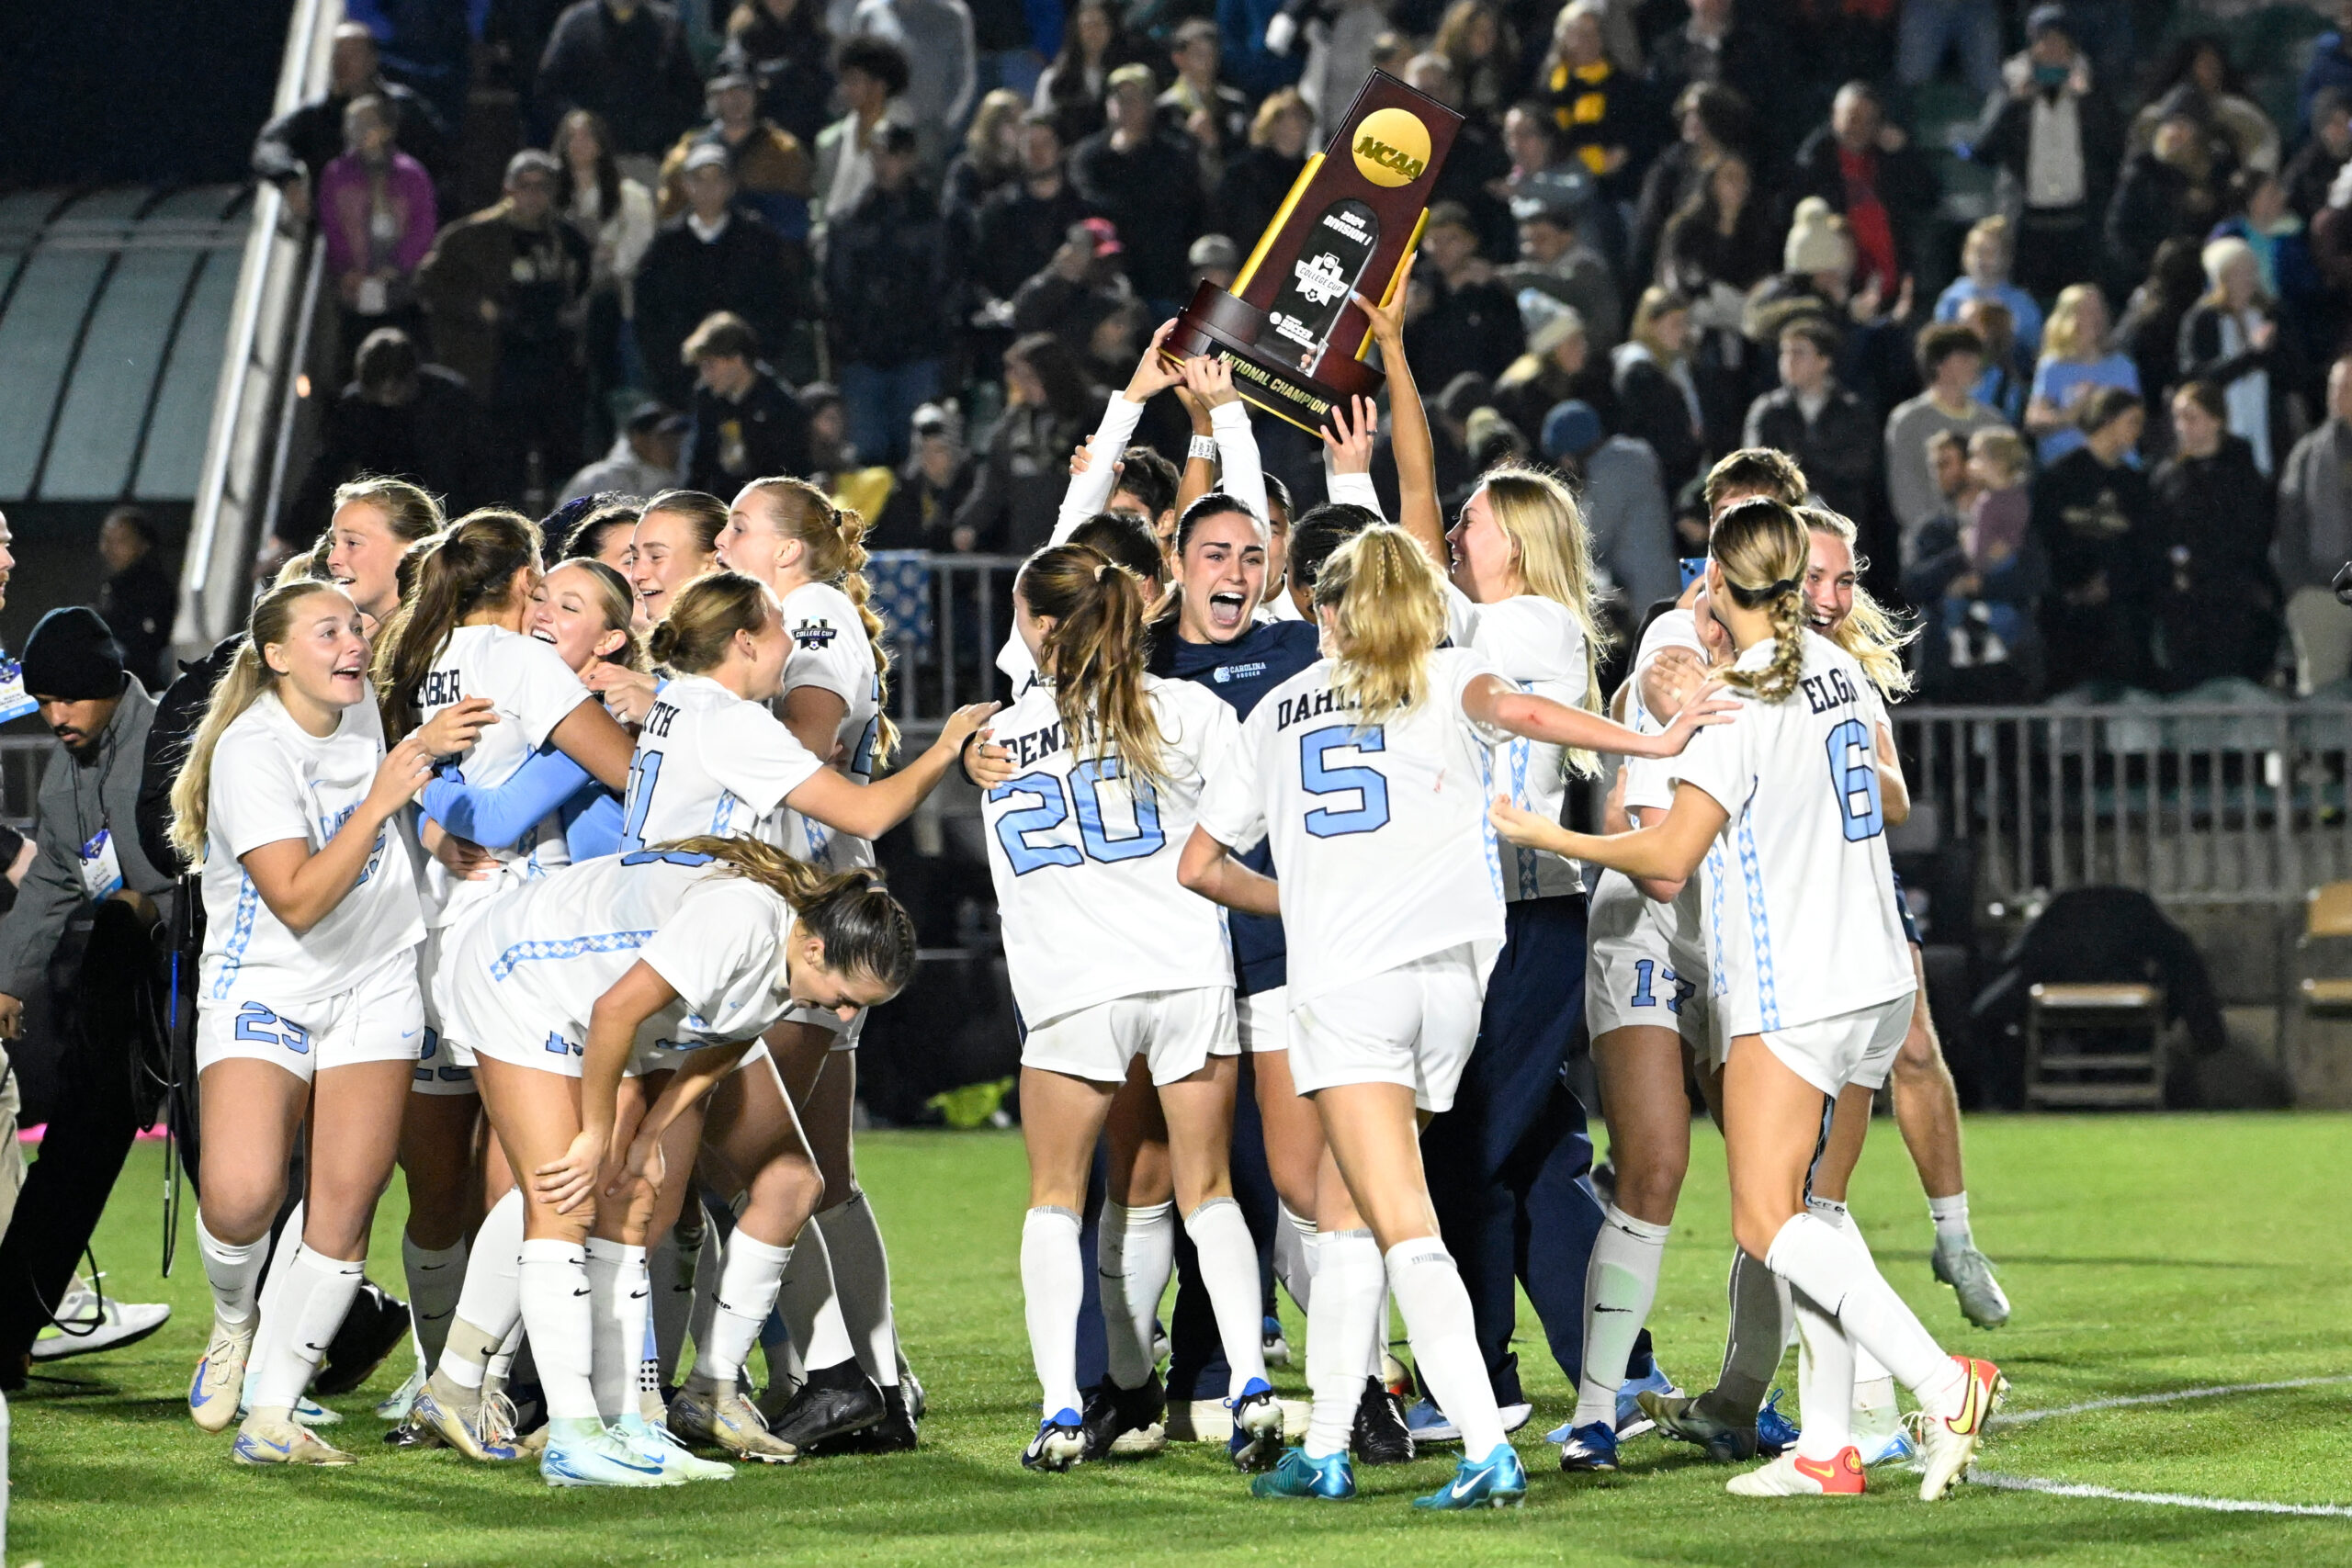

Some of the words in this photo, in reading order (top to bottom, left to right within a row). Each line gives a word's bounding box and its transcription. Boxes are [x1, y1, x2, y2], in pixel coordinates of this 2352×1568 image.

[1353, 134, 1424, 181] NCAA
[1322, 214, 1368, 243] DIVISION
[1340, 210, 1367, 230] 2024
[1299, 266, 1329, 286] COLLEGE
[1327, 281, 1343, 293] CUP
[1217, 350, 1272, 387] NATIONAL
[1269, 378, 1330, 415] CHAMPION
[1230, 661, 1267, 673] CAROLINA
[644, 700, 681, 738] ITH
[1299, 723, 1391, 840] 5
[1826, 718, 1883, 843] 6
[988, 754, 1167, 877] 20
